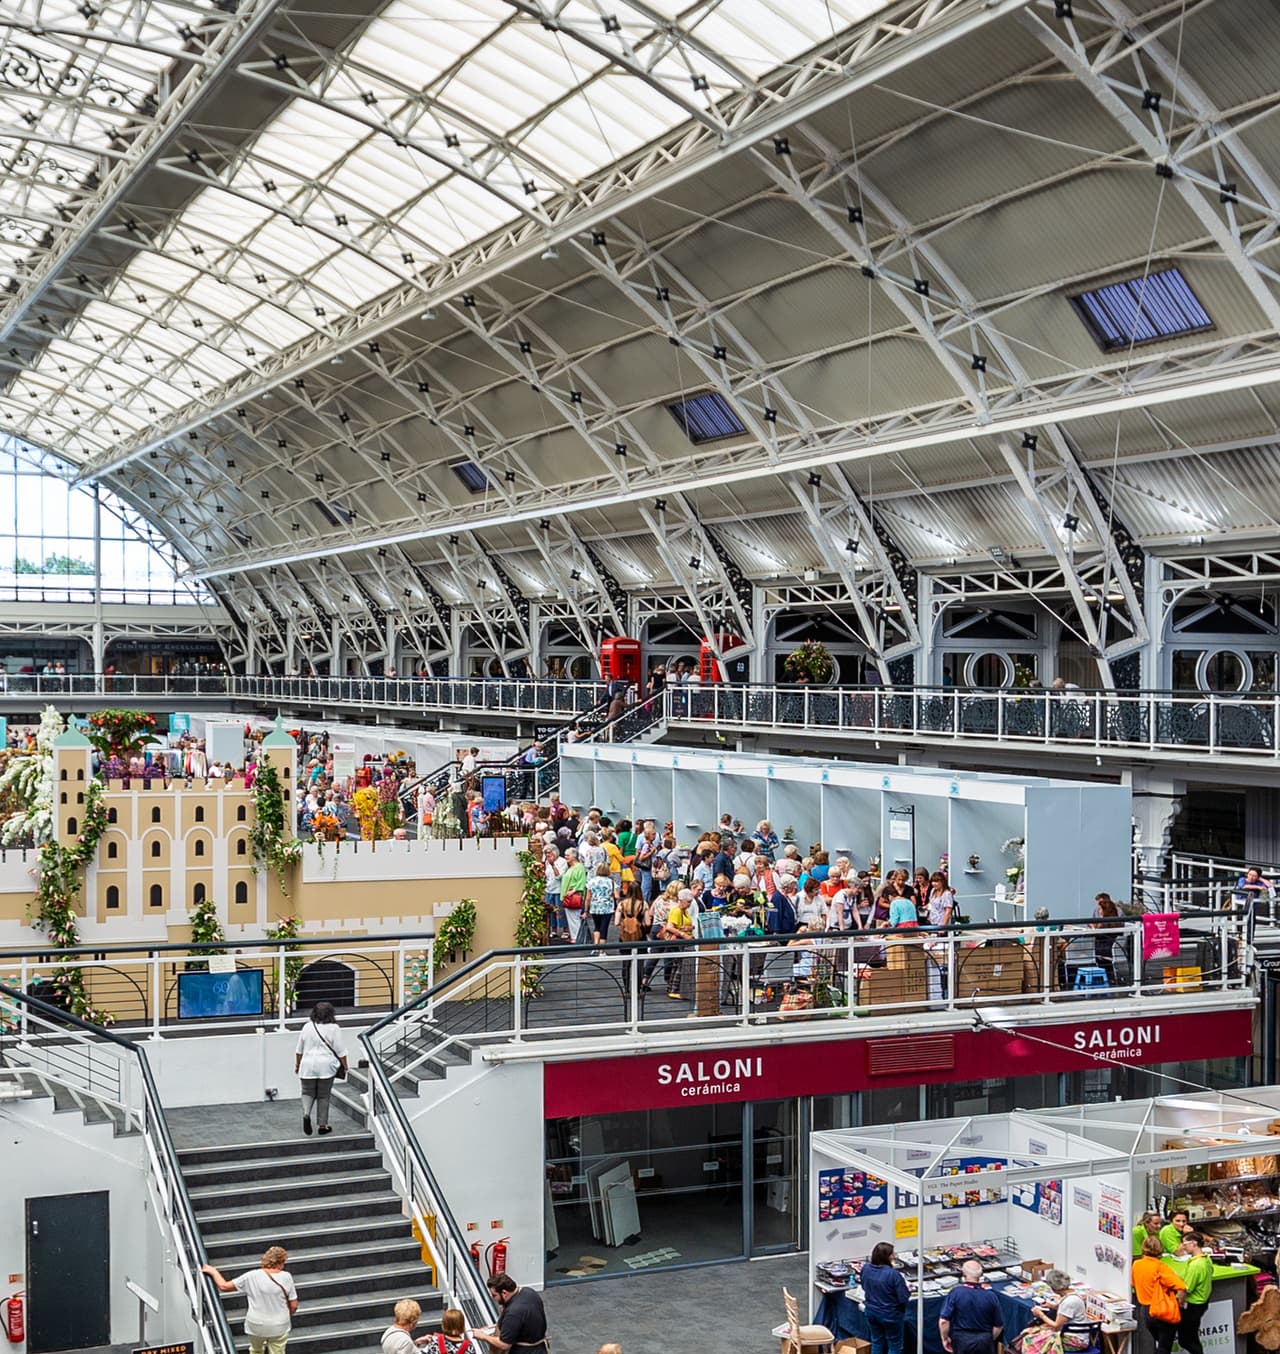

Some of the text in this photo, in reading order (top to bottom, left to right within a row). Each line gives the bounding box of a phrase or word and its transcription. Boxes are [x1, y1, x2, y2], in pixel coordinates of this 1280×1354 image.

[1073, 1025, 1161, 1050] SALONI
[1093, 1046, 1143, 1062] cerámica
[657, 1057, 763, 1085] SALONI
[680, 1079, 741, 1097] cerámica
[1200, 1324, 1229, 1336] HEAST
